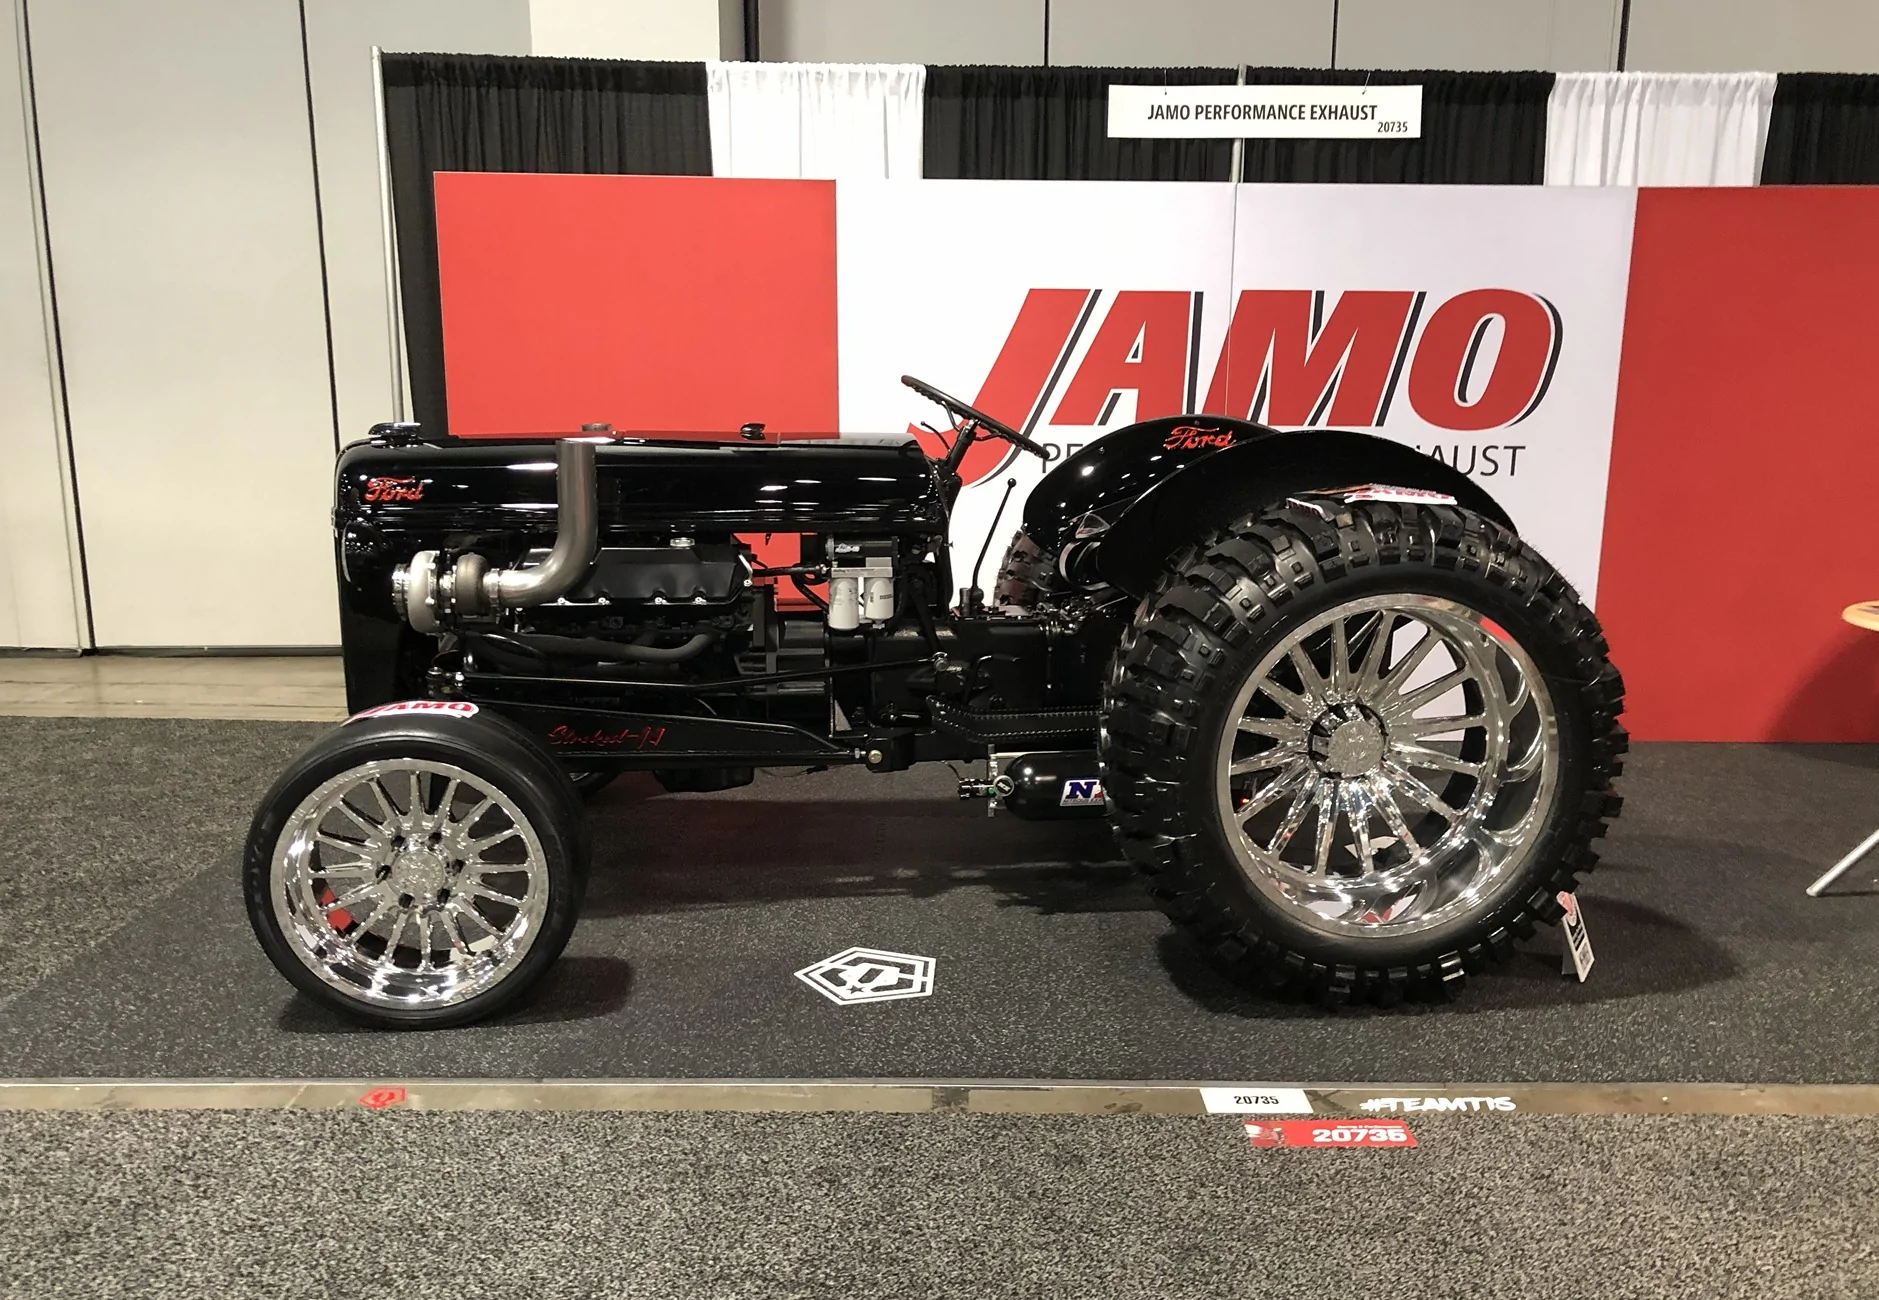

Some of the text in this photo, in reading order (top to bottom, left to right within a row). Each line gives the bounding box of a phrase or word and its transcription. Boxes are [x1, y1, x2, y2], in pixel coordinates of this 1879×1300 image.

[1147, 104, 1378, 121] JAMO PERFORMANCE EXHAUST
[1377, 121, 1408, 133] 20735
[907, 288, 1563, 488] JAMO
[1163, 426, 1237, 450] Ford
[365, 477, 425, 501] Ford
[1233, 1095, 1280, 1105] 20735
[1359, 1097, 1517, 1112] #TEAMTIS
[1312, 1128, 1408, 1143] 20735
